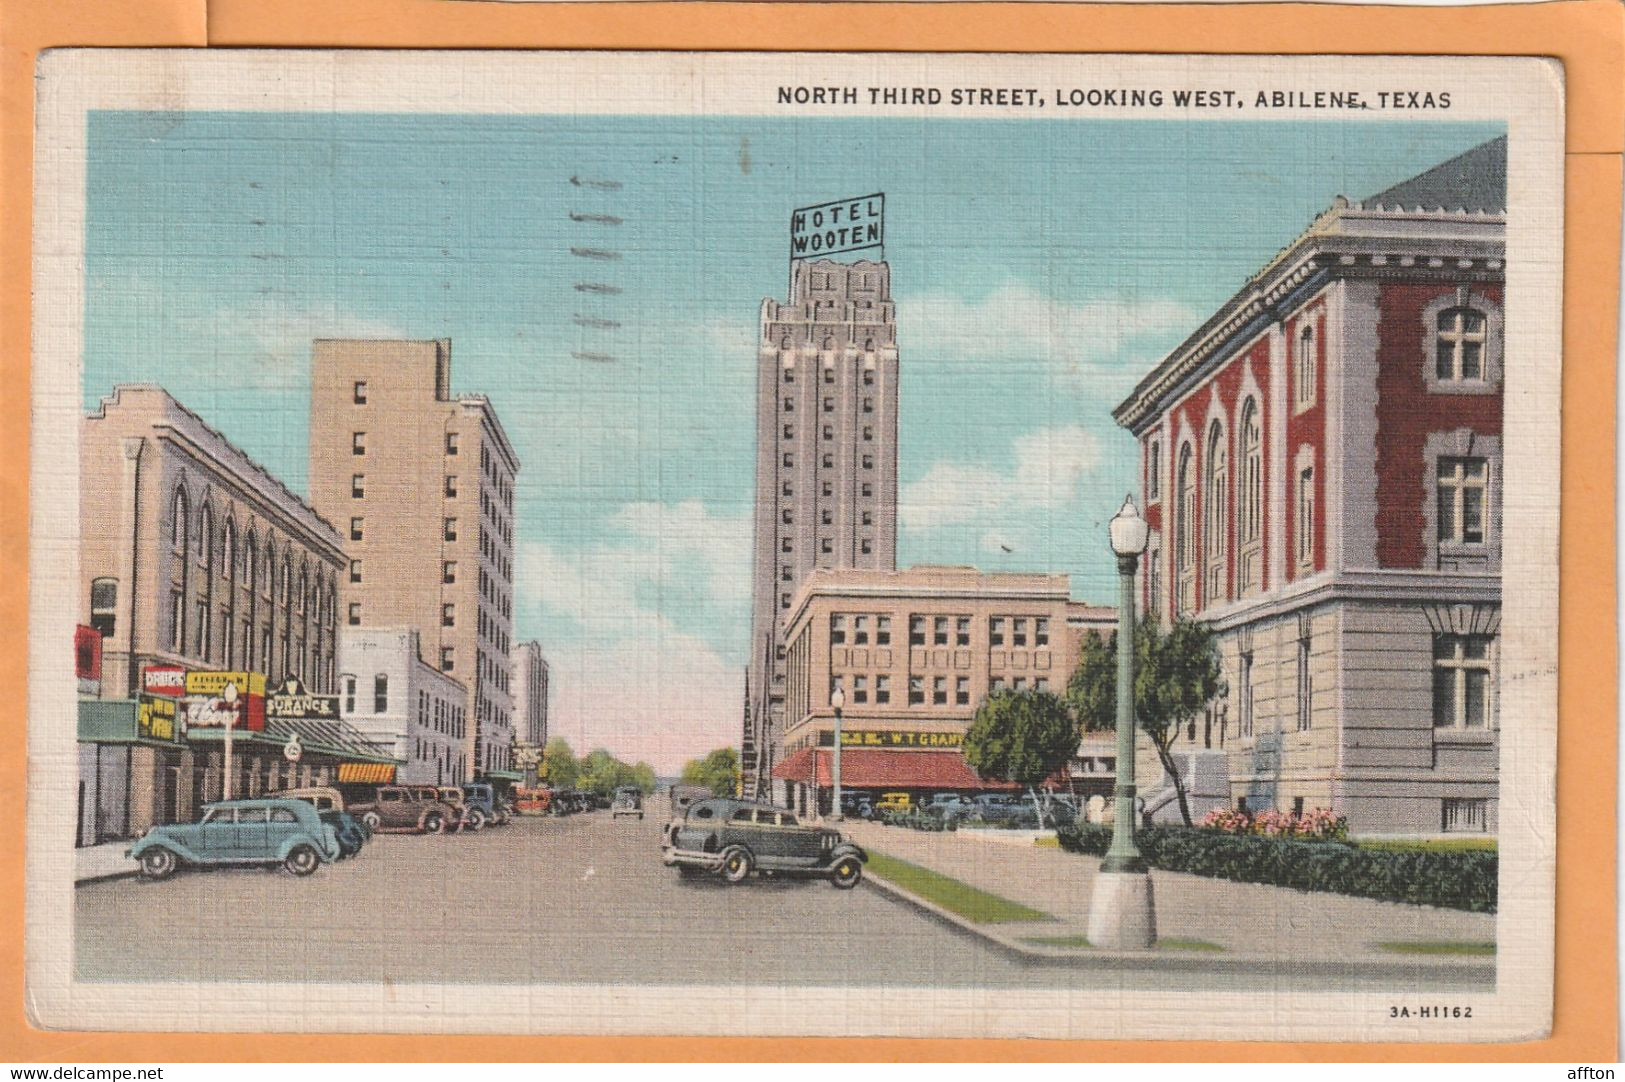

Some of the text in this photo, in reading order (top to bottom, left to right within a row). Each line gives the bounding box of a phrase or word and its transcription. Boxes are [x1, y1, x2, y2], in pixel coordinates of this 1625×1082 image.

[778, 86, 1451, 110] NORTH THIRD STREET, LOOKING WEST, ABILENE, TEXAS
[795, 201, 879, 233] HOTEL
[792, 222, 878, 252] WOOTEN
[145, 671, 184, 688] DRUGS
[1390, 1006, 1472, 1018] 3A-H1162
